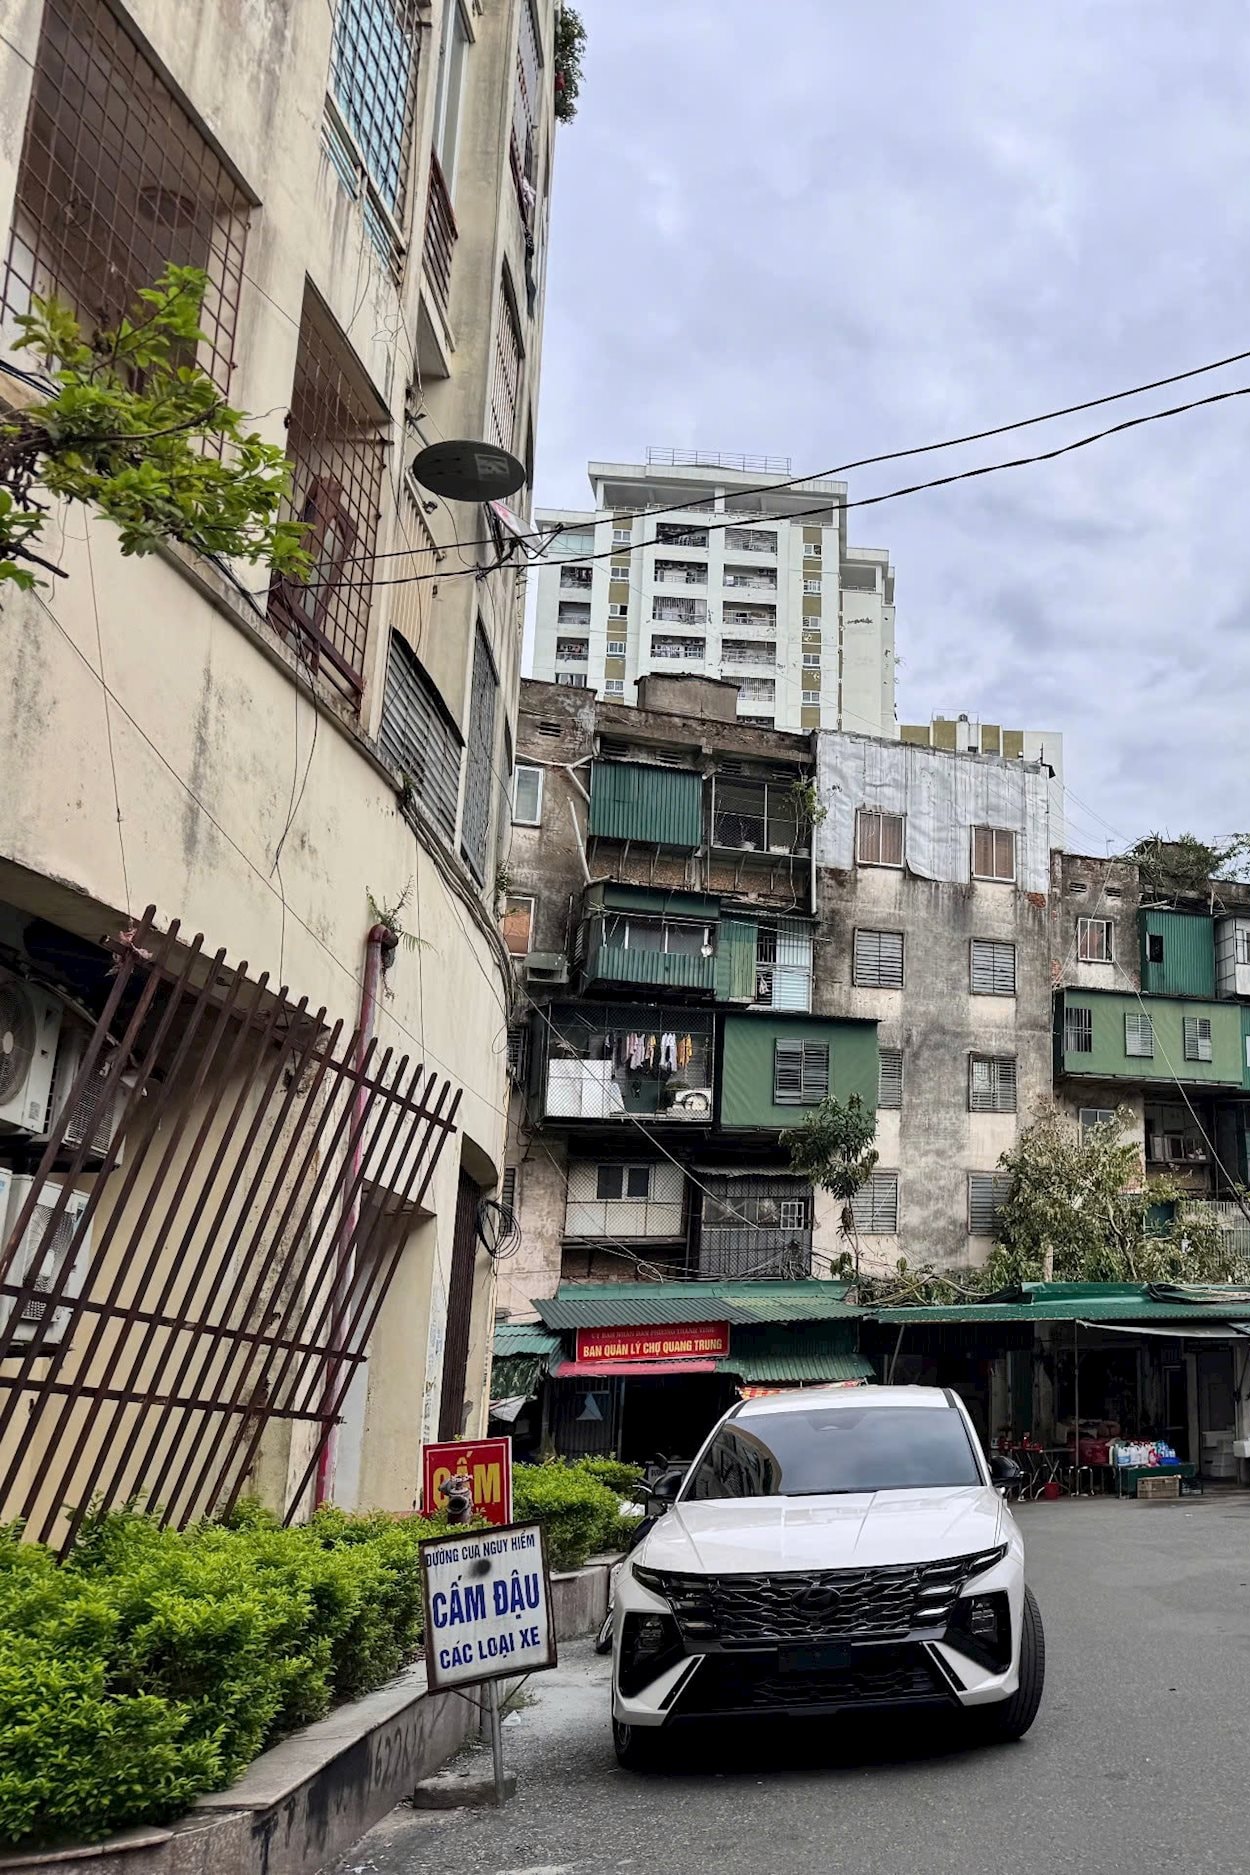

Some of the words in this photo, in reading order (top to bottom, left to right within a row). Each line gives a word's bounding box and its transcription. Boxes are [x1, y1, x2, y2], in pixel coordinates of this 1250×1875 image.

[583, 1345, 602, 1358] BAN
[604, 1340, 629, 1357] QUẢN
[630, 1341, 641, 1355] LÝ
[643, 1341, 662, 1356] CHỢ
[664, 1340, 692, 1353] QUANG
[693, 1338, 723, 1351] TRUNG
[462, 1544, 481, 1561] CUA
[483, 1538, 509, 1557] NGUY
[511, 1529, 535, 1550] HIỂM
[432, 1575, 487, 1629] CẤM
[493, 1569, 540, 1620] ĐẬU
[439, 1641, 474, 1670] CÁC
[478, 1631, 516, 1660] LOẠI
[520, 1625, 541, 1649] XE
